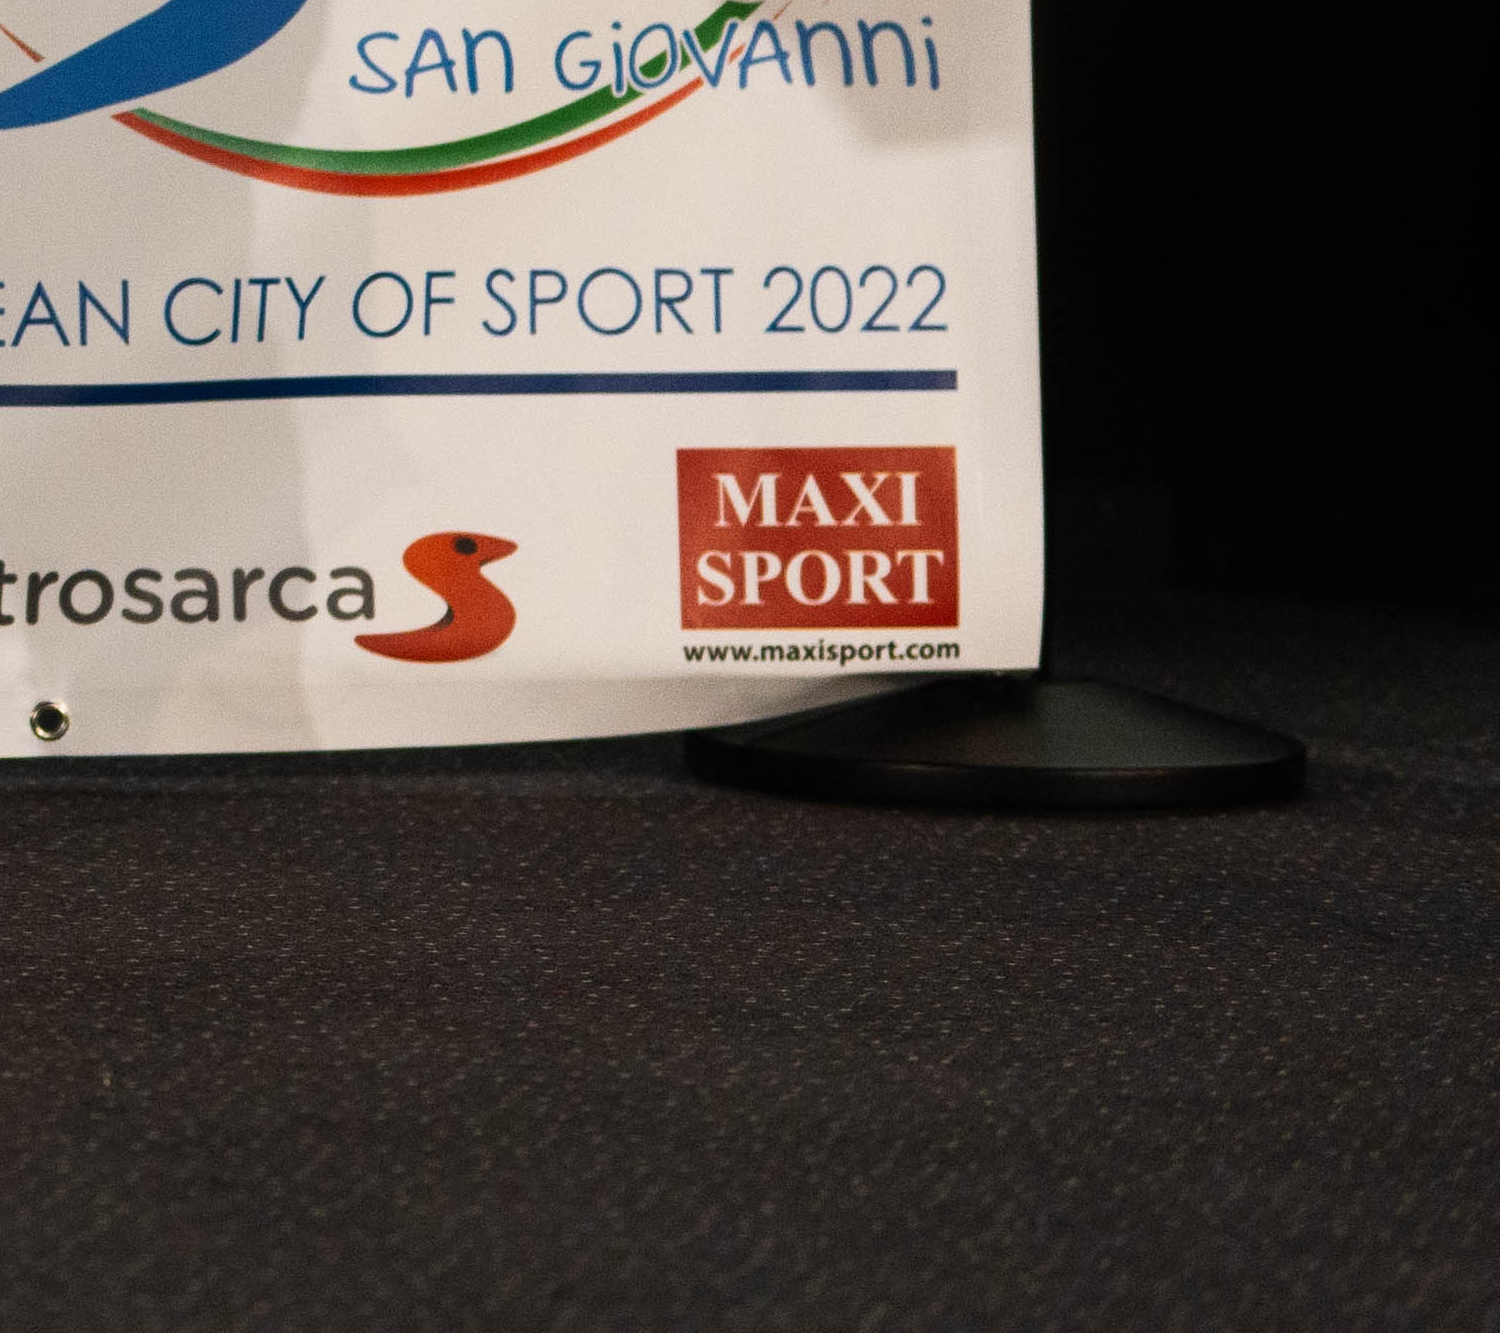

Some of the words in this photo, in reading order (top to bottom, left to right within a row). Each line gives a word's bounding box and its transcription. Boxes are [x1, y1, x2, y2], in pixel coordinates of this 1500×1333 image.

[163, 276, 322, 349] CITY
[350, 269, 460, 339] OF
[483, 266, 736, 338] SPORT
[762, 263, 951, 336] 2022
[712, 470, 922, 528] MAXI
[695, 549, 946, 607] SPORT
[682, 638, 961, 666] www.maxisport.com
